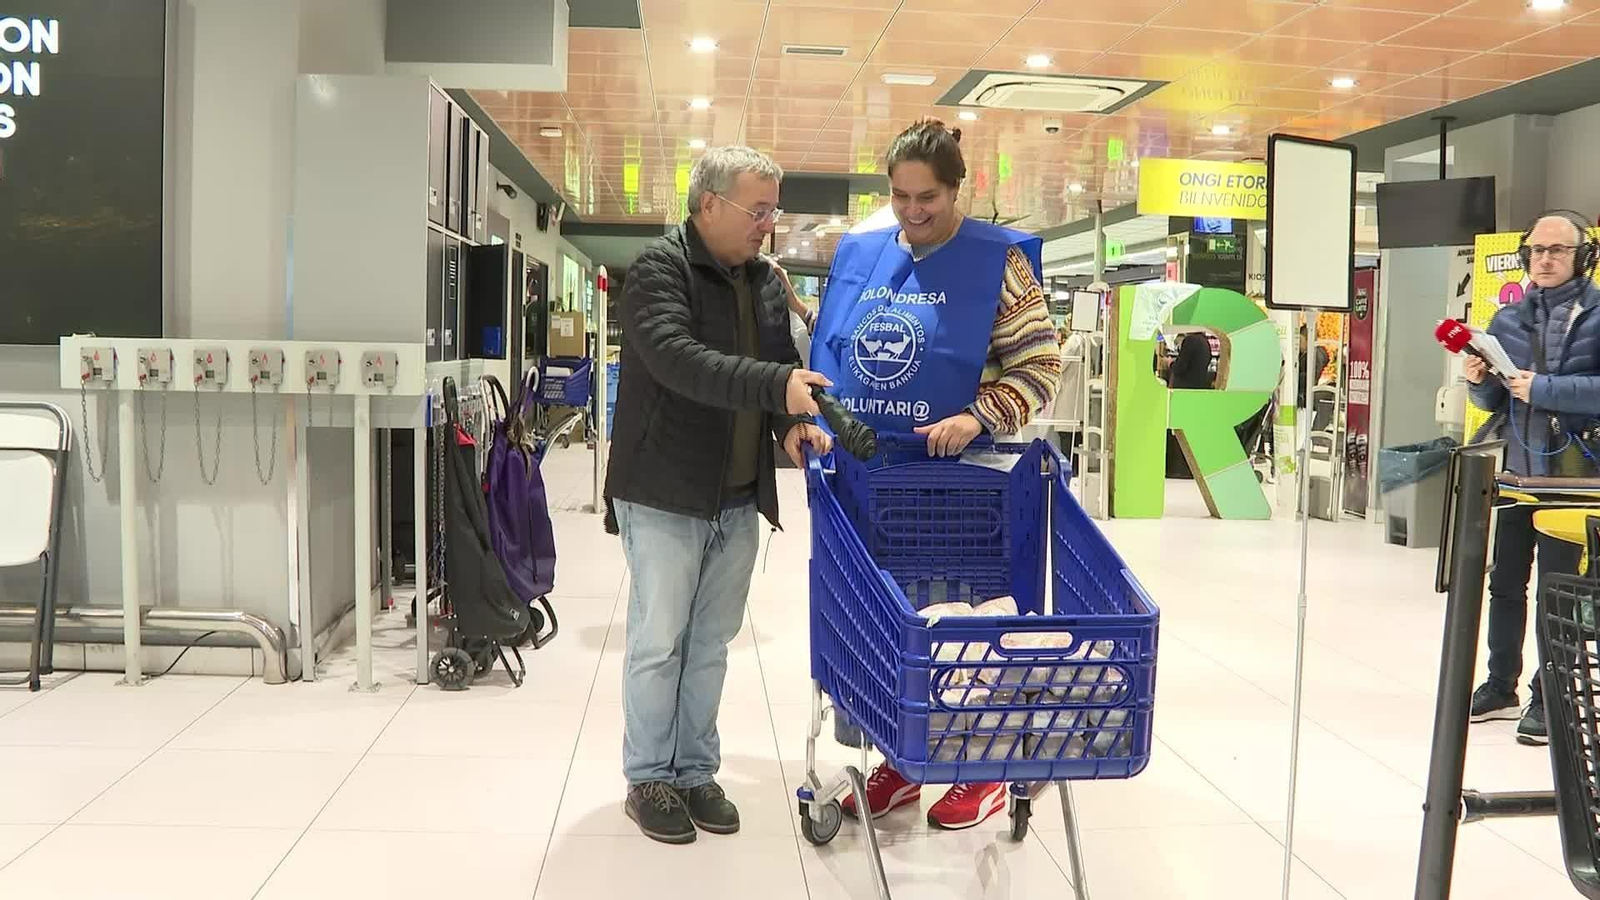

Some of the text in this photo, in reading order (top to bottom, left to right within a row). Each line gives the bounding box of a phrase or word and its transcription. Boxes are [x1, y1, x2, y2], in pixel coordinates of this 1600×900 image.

[0, 17, 59, 54] ON
[1180, 172, 1268, 190] ONGI ETOR
[1486, 252, 1524, 272] VIERN
[869, 322, 906, 334] FESBAL
[891, 306, 926, 344] ALIMENTOS
[889, 359, 922, 390] BANKUA
[1350, 360, 1369, 379] 100%
[840, 397, 930, 421] OLUNTARI@
